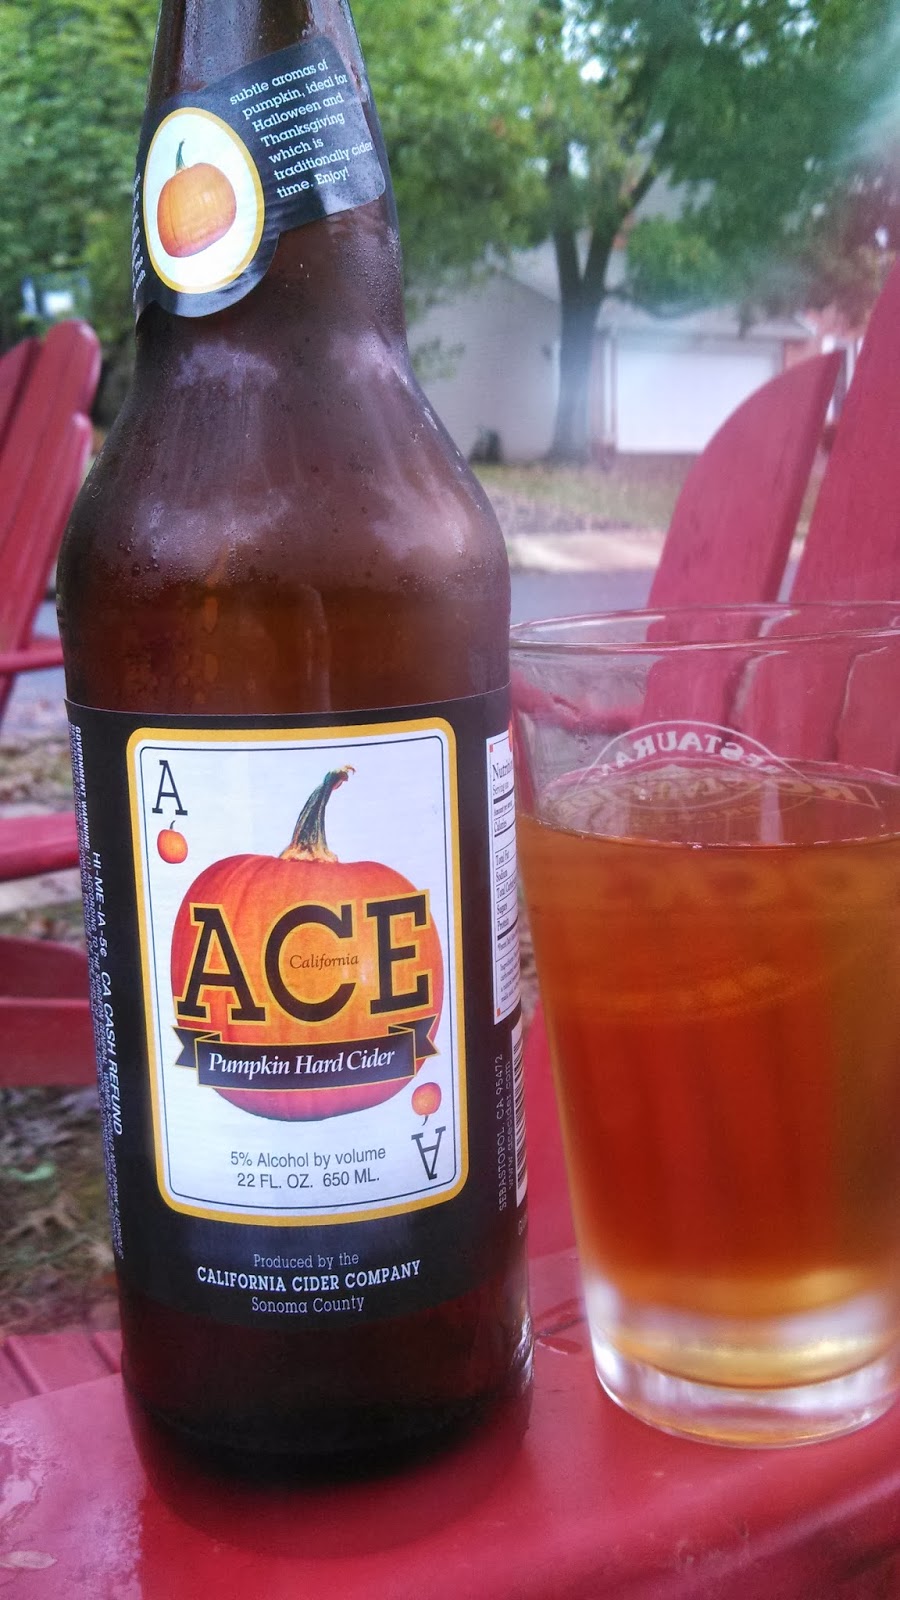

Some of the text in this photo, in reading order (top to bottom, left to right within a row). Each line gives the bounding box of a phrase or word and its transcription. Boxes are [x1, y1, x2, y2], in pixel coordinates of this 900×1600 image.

[230, 59, 329, 105] subtle aromas of
[242, 74, 348, 120] pumpkin, ideal for
[252, 92, 344, 132] Halloween and
[261, 112, 345, 148] Thanksgiving
[268, 138, 324, 164] which is
[274, 141, 373, 181] traditionally cider
[277, 167, 350, 198] time. Enjoy!
[152, 760, 188, 816] A
[75, 726, 86, 796] GOVERNMENT
[81, 801, 89, 851] WARNING:
[87, 872, 95, 931] ACCORDING
[175, 890, 432, 1025] ACE
[290, 954, 359, 971] California
[103, 972, 110, 995] CA
[104, 1003, 116, 1054] CASH
[209, 1048, 395, 1080] Pumpkin Hard Cider
[495, 1055, 503, 1096] 95472
[108, 1059, 122, 1134] REFUND
[497, 1101, 505, 1119] CA
[505, 1061, 513, 1190] wwwacecidercom
[230, 1146, 386, 1169] 5% Alcohol by volume
[411, 1126, 446, 1180] A
[237, 1169, 379, 1188] 22 FL. OZ. 650 ML.
[197, 1259, 421, 1293] CALIFORNIA CIDER COMPANY
[254, 1252, 359, 1269] Produced by the
[252, 1296, 364, 1314] Sonoma County
